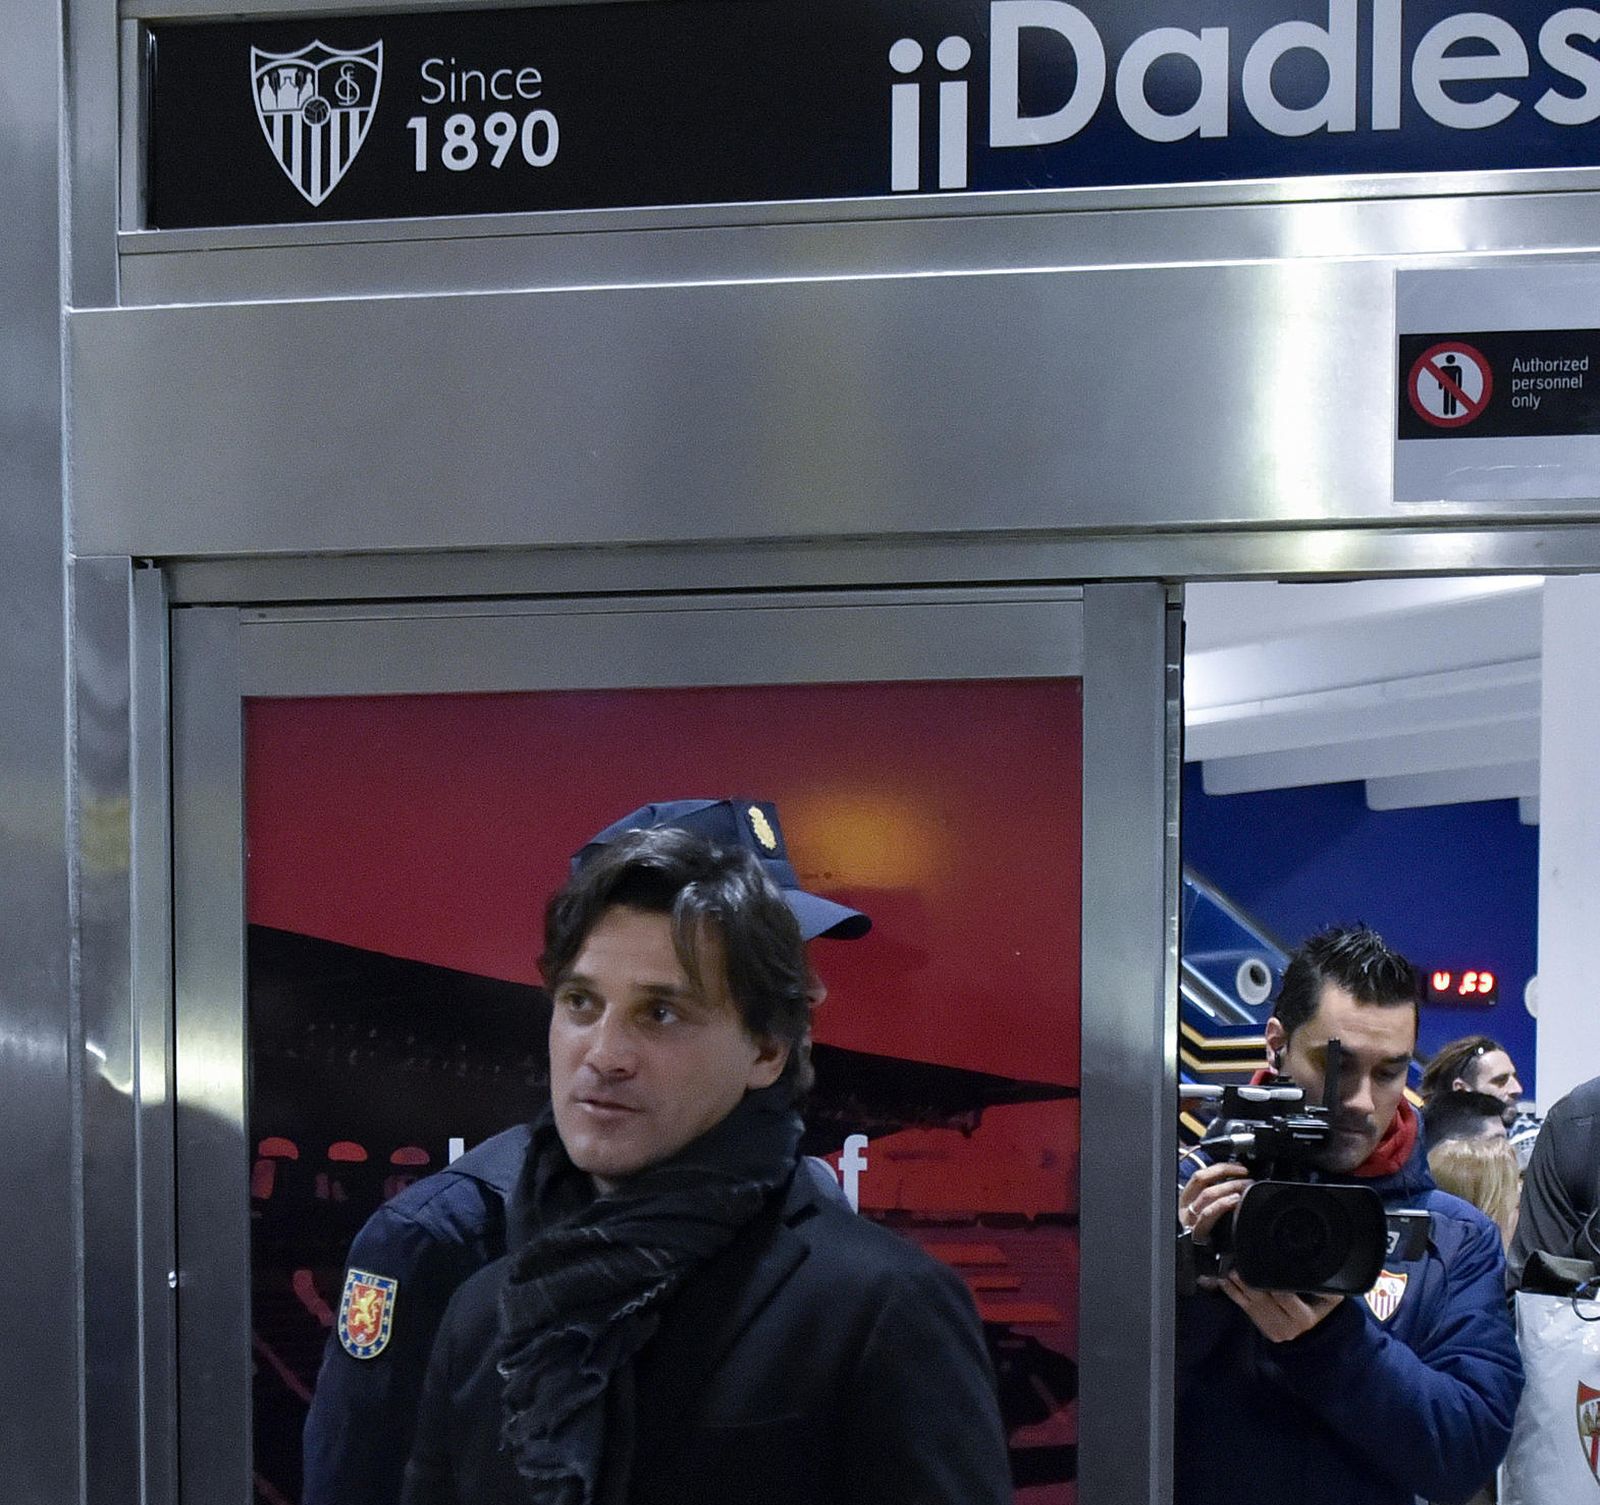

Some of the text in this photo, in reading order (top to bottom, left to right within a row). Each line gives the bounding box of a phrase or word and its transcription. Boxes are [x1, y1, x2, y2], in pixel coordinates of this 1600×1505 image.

[421, 58, 541, 103] Since
[406, 110, 560, 172] 1890
[1512, 356, 1589, 373] Authorized
[1512, 374, 1583, 391] personnel
[1512, 393, 1541, 410] only
